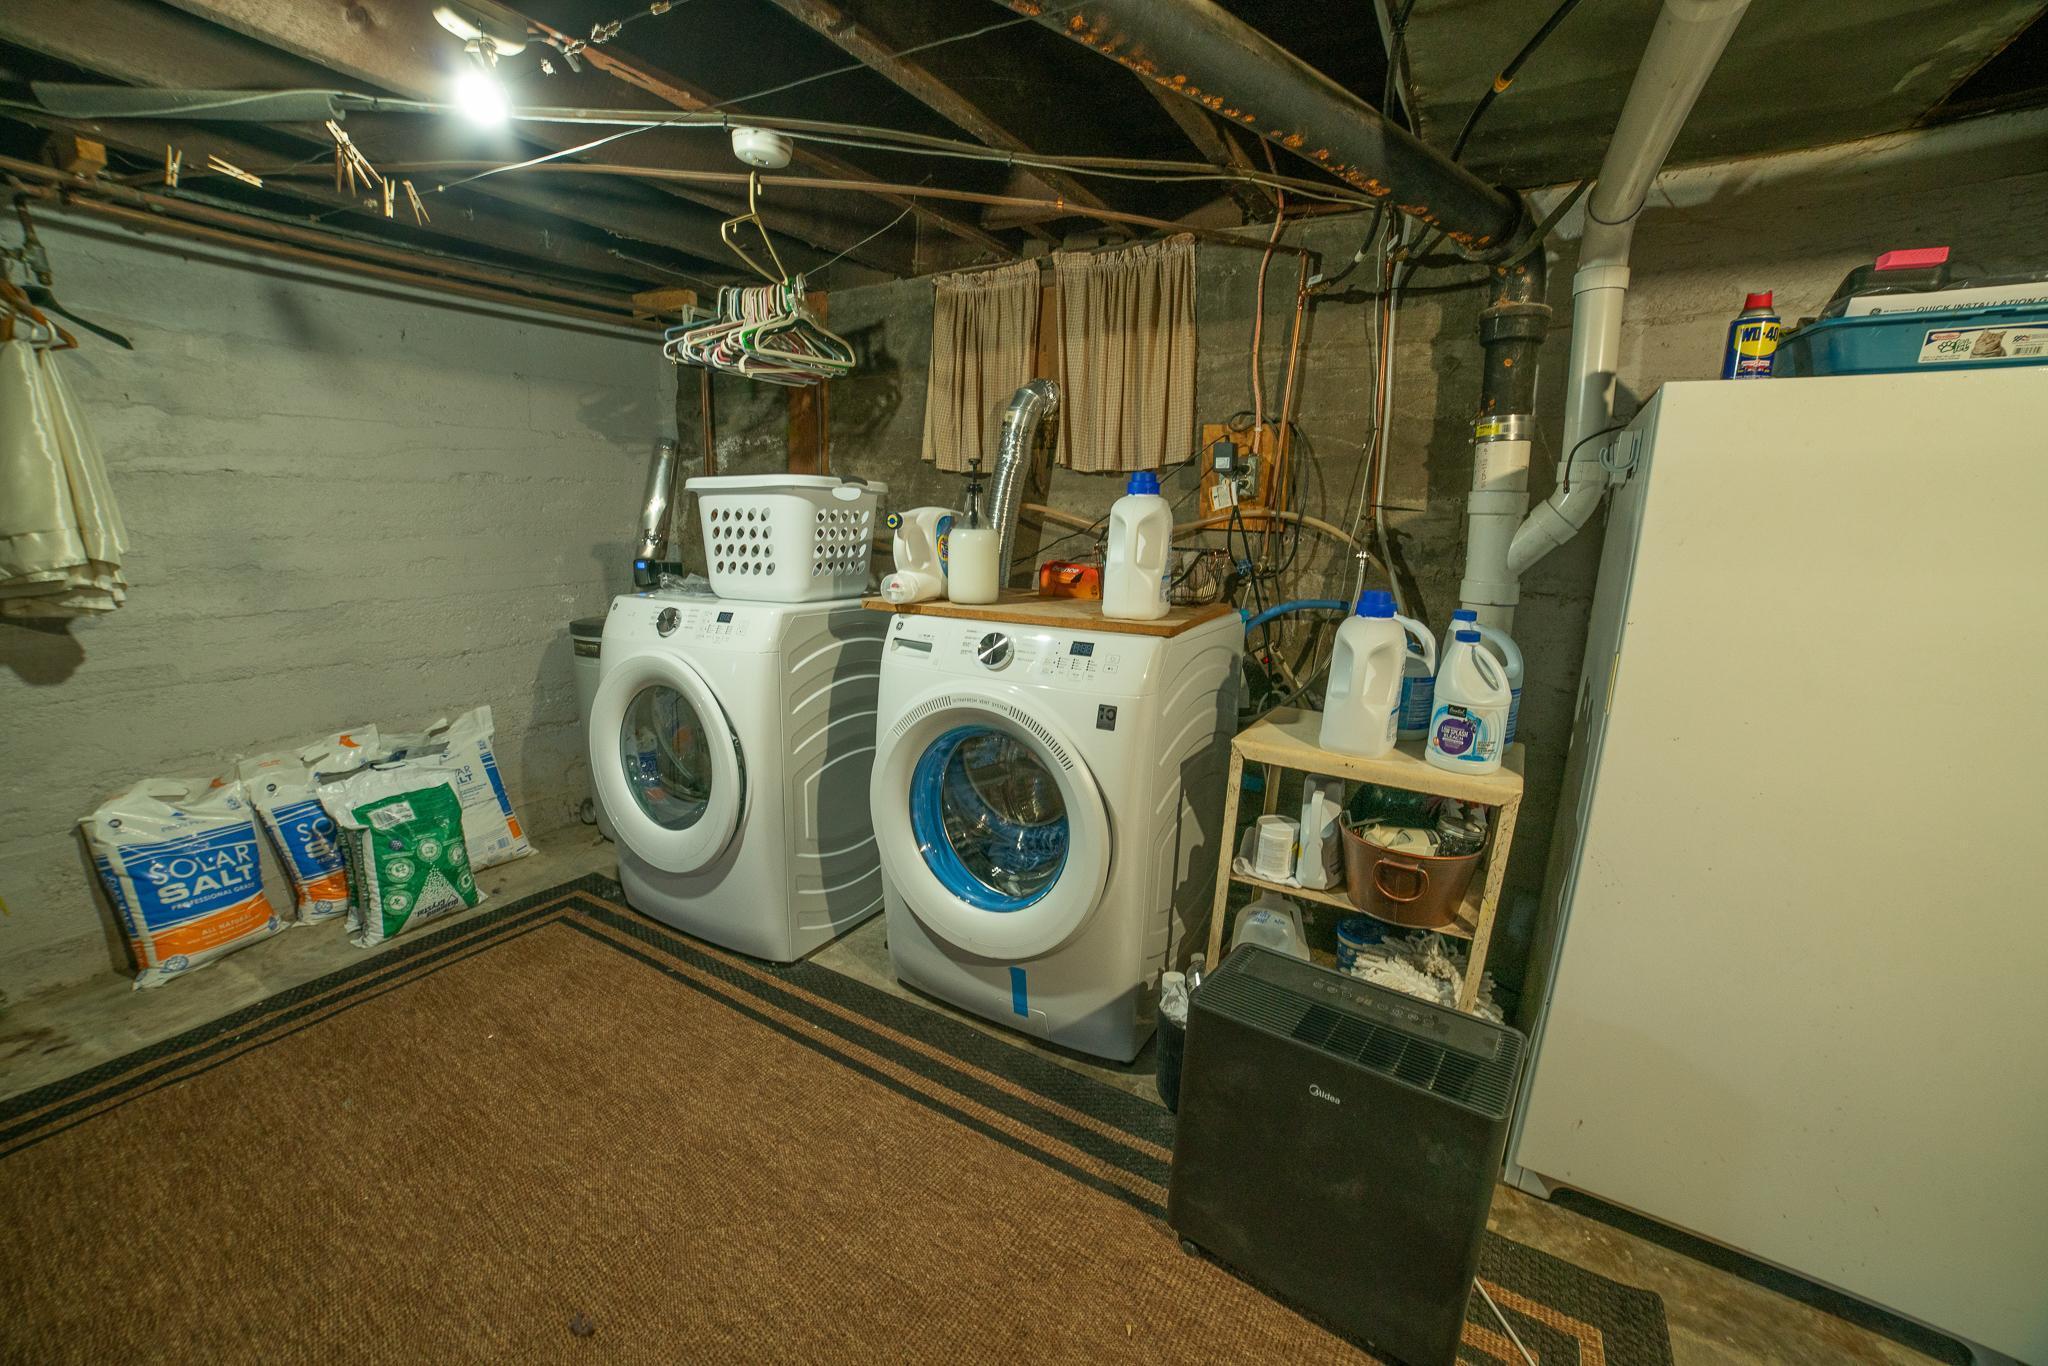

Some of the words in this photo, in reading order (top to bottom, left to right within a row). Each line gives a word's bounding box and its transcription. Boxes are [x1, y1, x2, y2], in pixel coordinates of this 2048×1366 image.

[1741, 325, 1779, 342] WD-40
[149, 844, 251, 885] SOLAR
[157, 862, 254, 905] SALT
[171, 889, 232, 911] PROFESSIONAL
[1309, 1084, 1341, 1105] Midea
